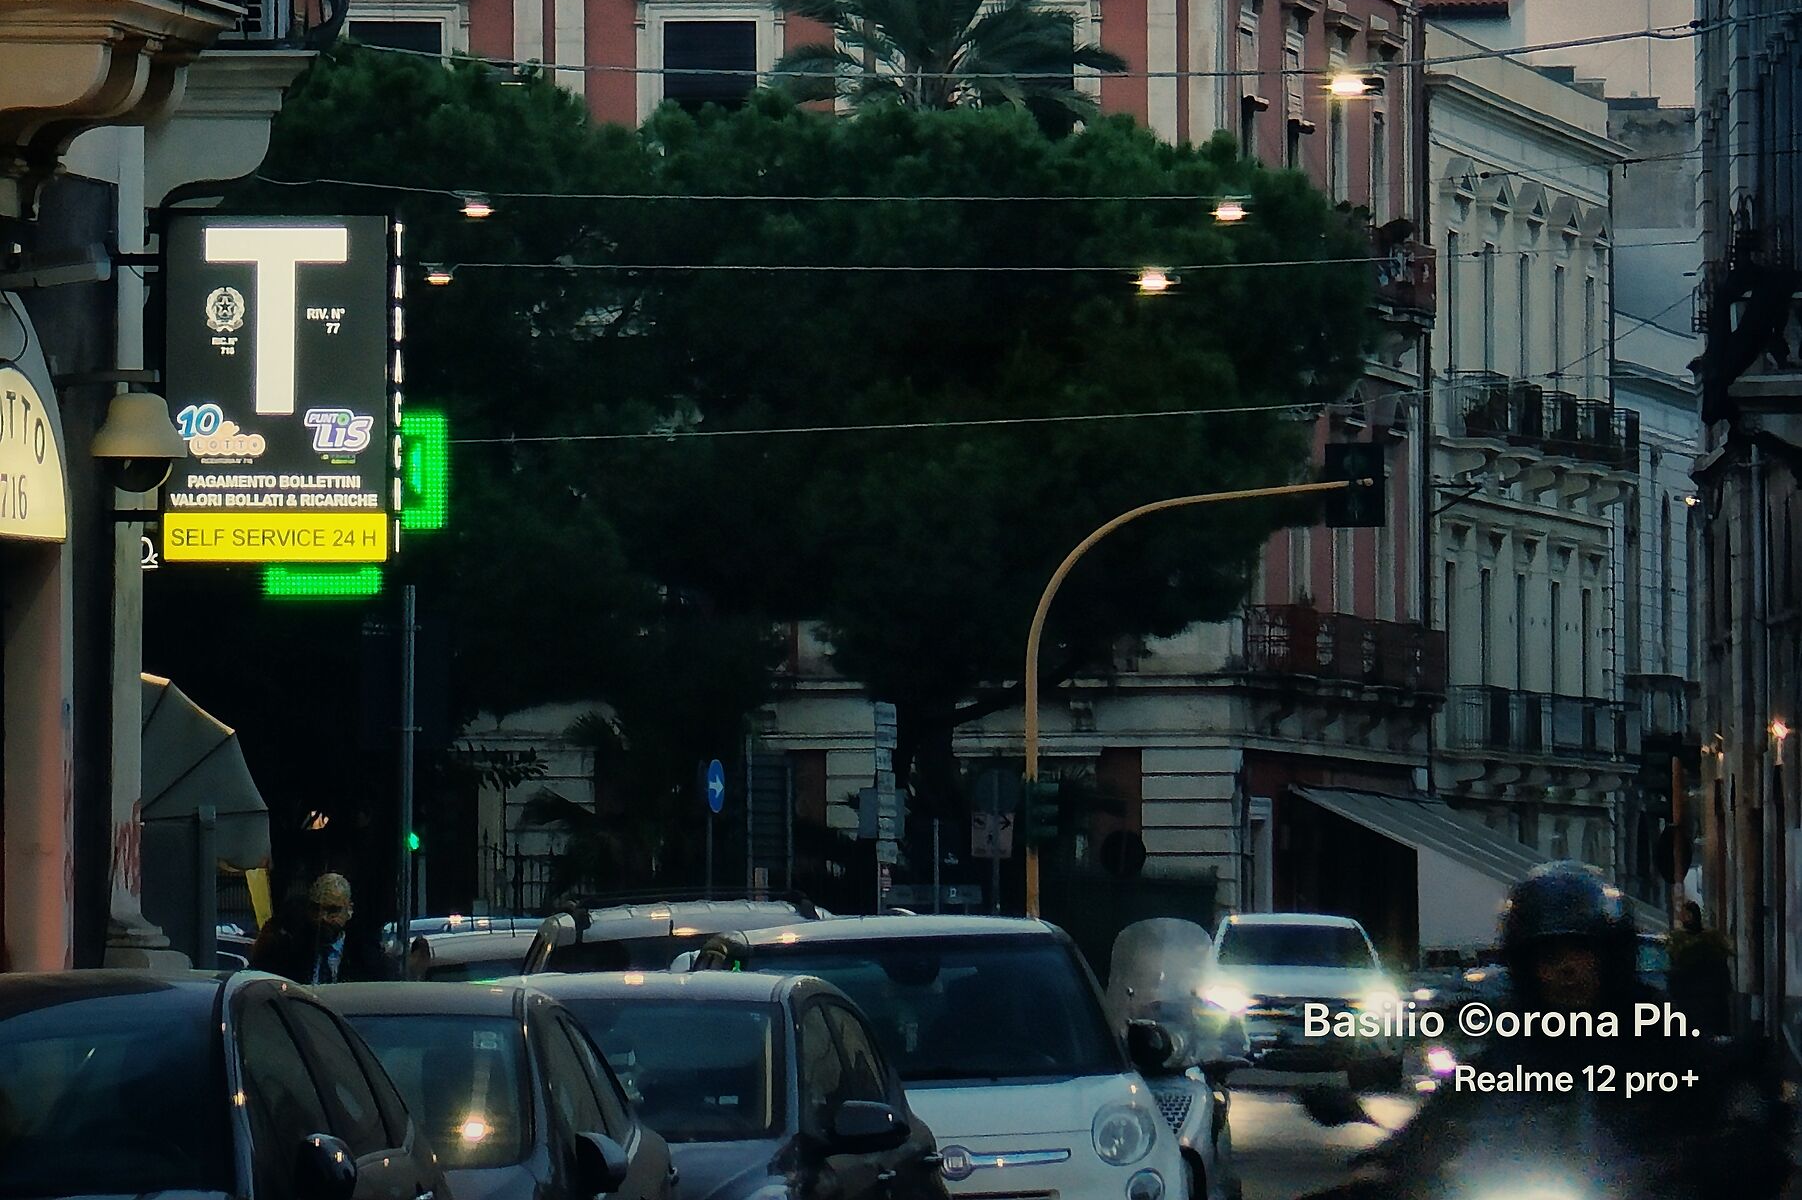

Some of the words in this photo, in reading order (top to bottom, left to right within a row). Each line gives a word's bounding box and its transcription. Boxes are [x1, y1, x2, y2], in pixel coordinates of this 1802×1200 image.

[205, 227, 348, 414] T
[306, 307, 329, 320] RIV.
[325, 322, 341, 334] 77
[177, 403, 223, 440] 10
[187, 475, 276, 488] PAGAMENTO
[279, 475, 361, 488] BOLLETTINI
[170, 493, 223, 507] VALORI
[225, 493, 284, 507] BOLLATI
[286, 493, 297, 506] &
[300, 493, 378, 507] RICARICHE
[171, 529, 225, 546] SELF
[232, 529, 325, 546] SERVICE
[332, 529, 356, 546] 24
[362, 529, 376, 546] H
